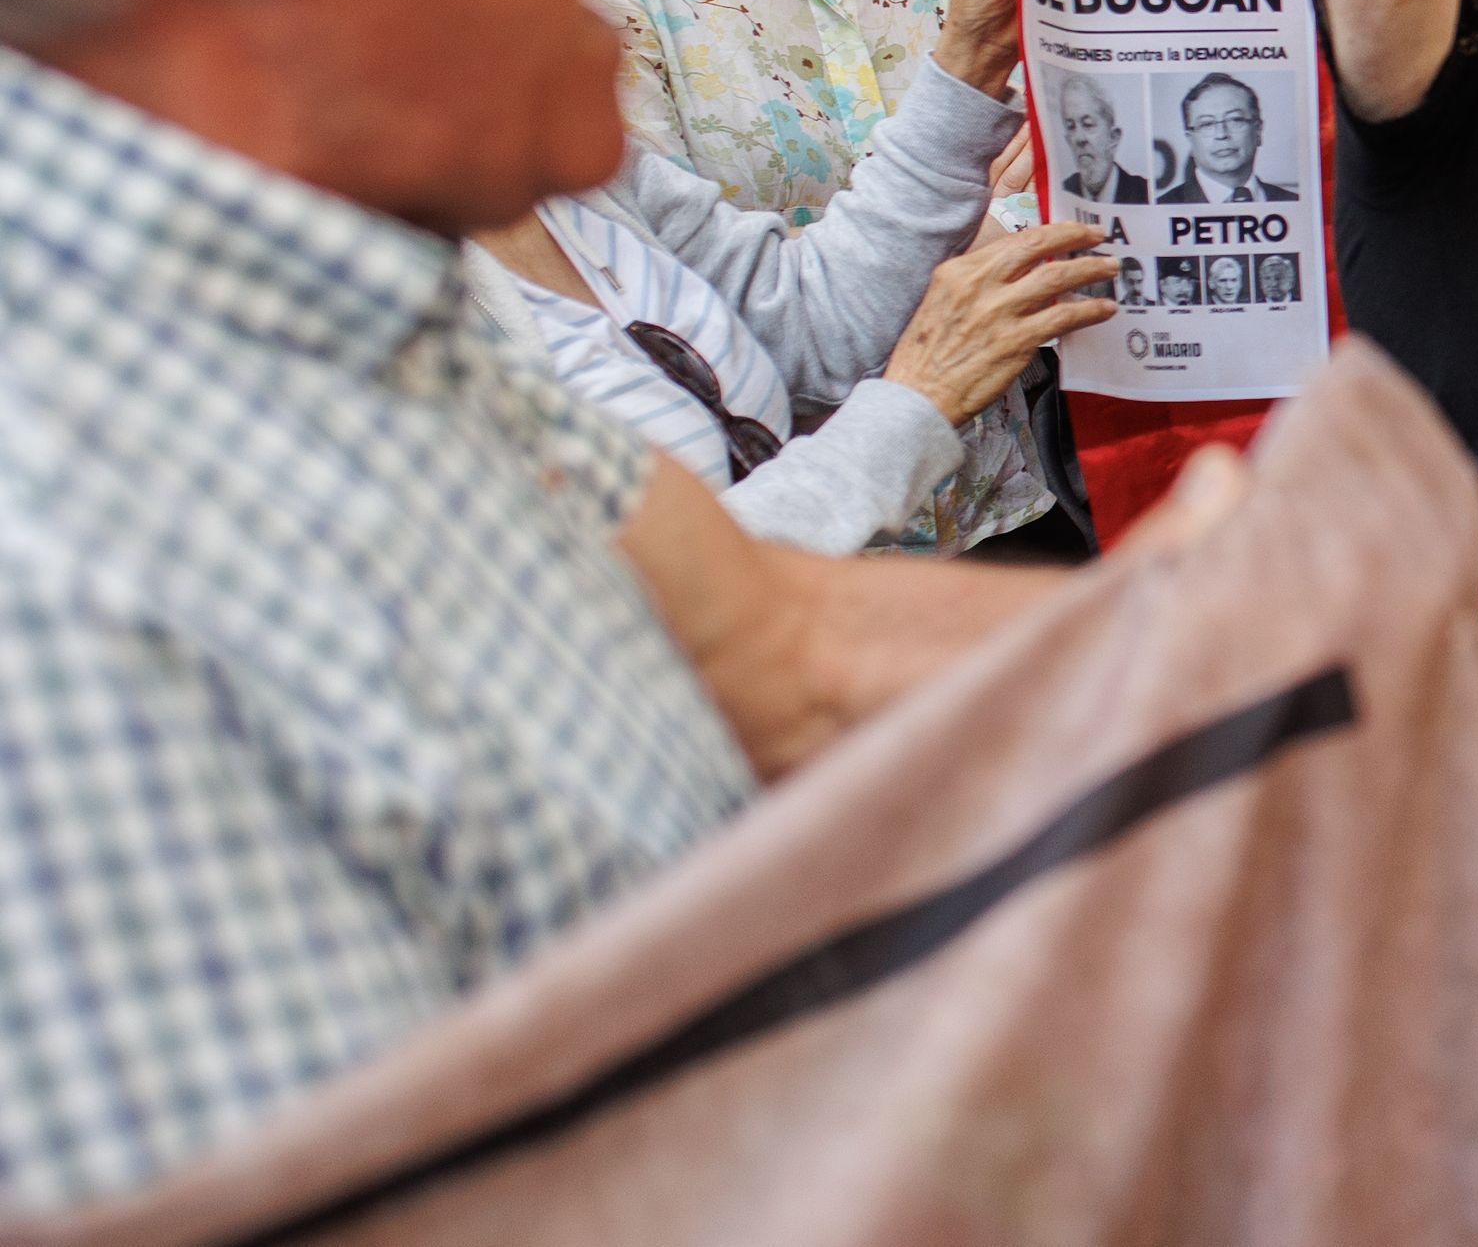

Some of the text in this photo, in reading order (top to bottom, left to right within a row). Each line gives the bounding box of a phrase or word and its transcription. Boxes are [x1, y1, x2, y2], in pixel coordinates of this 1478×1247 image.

[1117, 47, 1163, 61] contra
[1166, 47, 1180, 61] la
[1184, 46, 1288, 61] DEMOCRACIA
[1170, 213, 1288, 245] PETRO
[1153, 342, 1202, 358] MADRID
